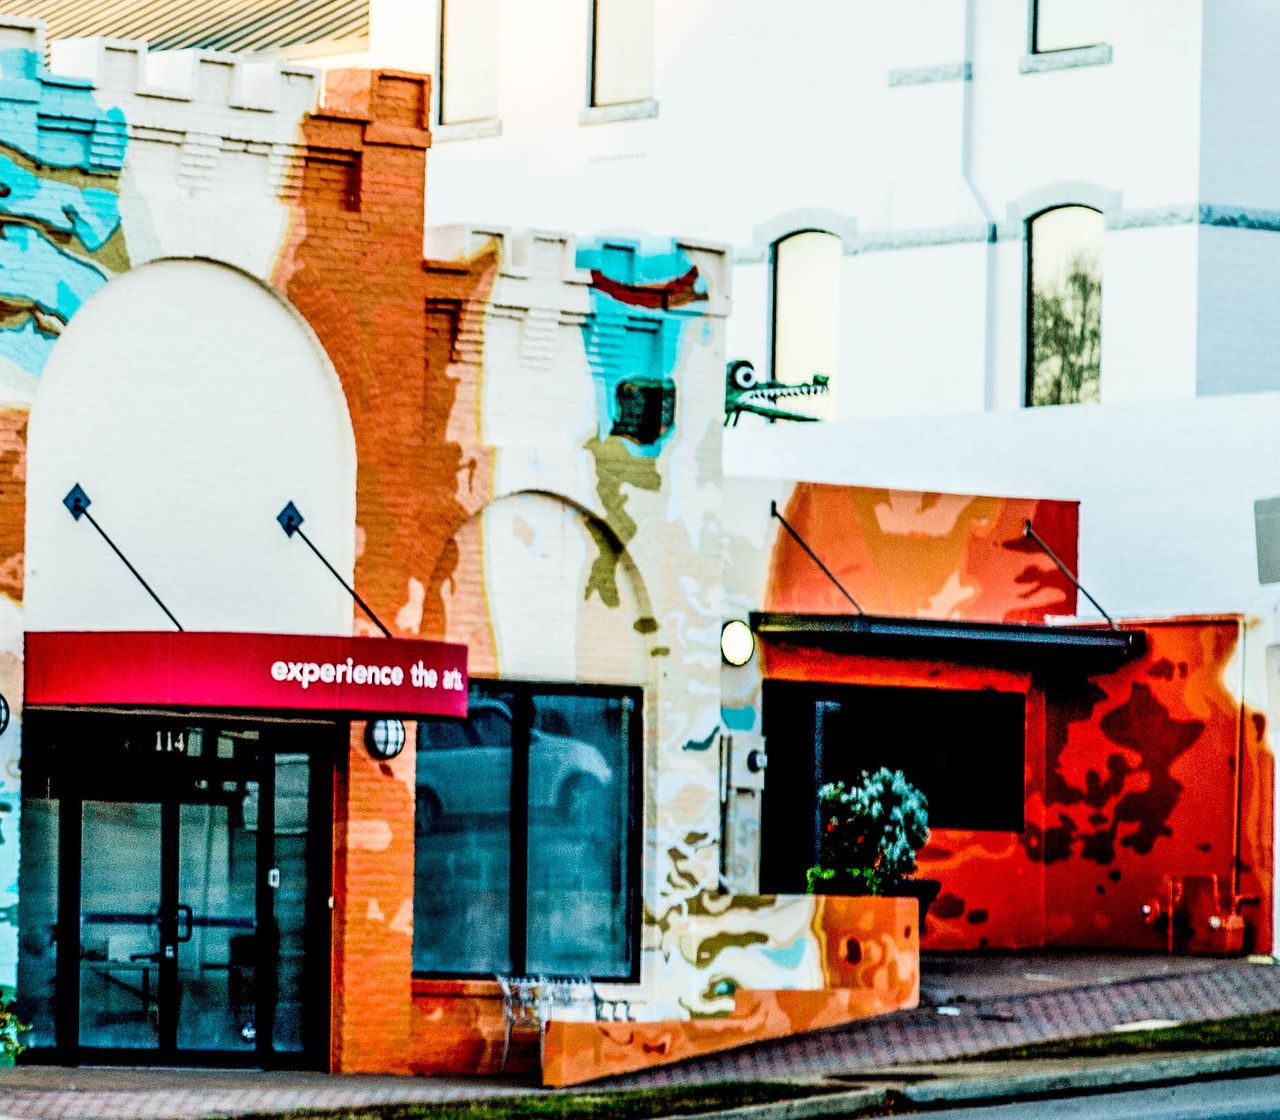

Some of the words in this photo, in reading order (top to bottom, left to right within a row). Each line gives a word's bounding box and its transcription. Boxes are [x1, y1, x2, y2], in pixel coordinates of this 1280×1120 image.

[271, 657, 404, 689] experience
[410, 660, 438, 689] the
[156, 731, 185, 752] 114
